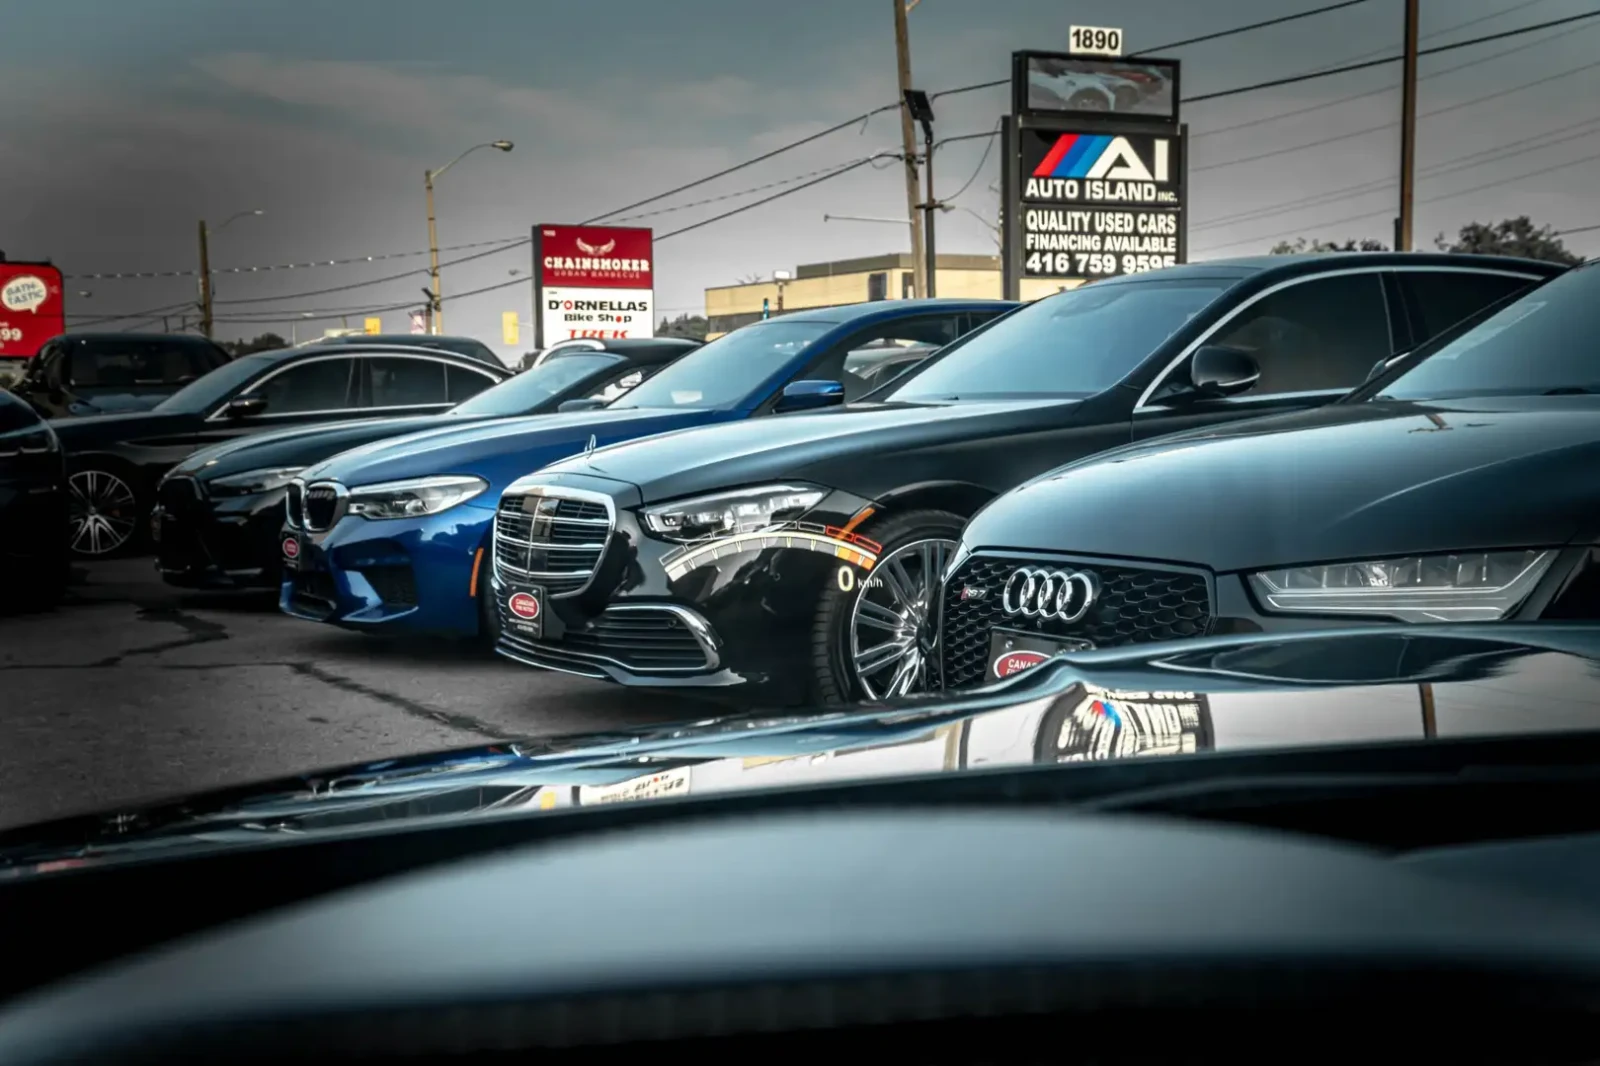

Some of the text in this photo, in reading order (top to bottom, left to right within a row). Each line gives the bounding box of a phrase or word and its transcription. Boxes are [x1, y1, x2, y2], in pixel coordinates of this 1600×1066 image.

[1072, 29, 1119, 50] 1890
[1025, 178, 1178, 202] AUTO ISLAND INC.
[1026, 209, 1176, 234] QUALITY USED CARS
[1026, 233, 1176, 252] FINANCING AVAILABLE
[544, 256, 650, 272] CHAINSMOKER
[1026, 252, 1069, 273] 416
[1075, 253, 1117, 273] 759
[591, 271, 640, 279] BARBECUE
[548, 300, 648, 311] D'ORNELLAS
[564, 314, 594, 322] Bike
[0, 327, 22, 342] 99
